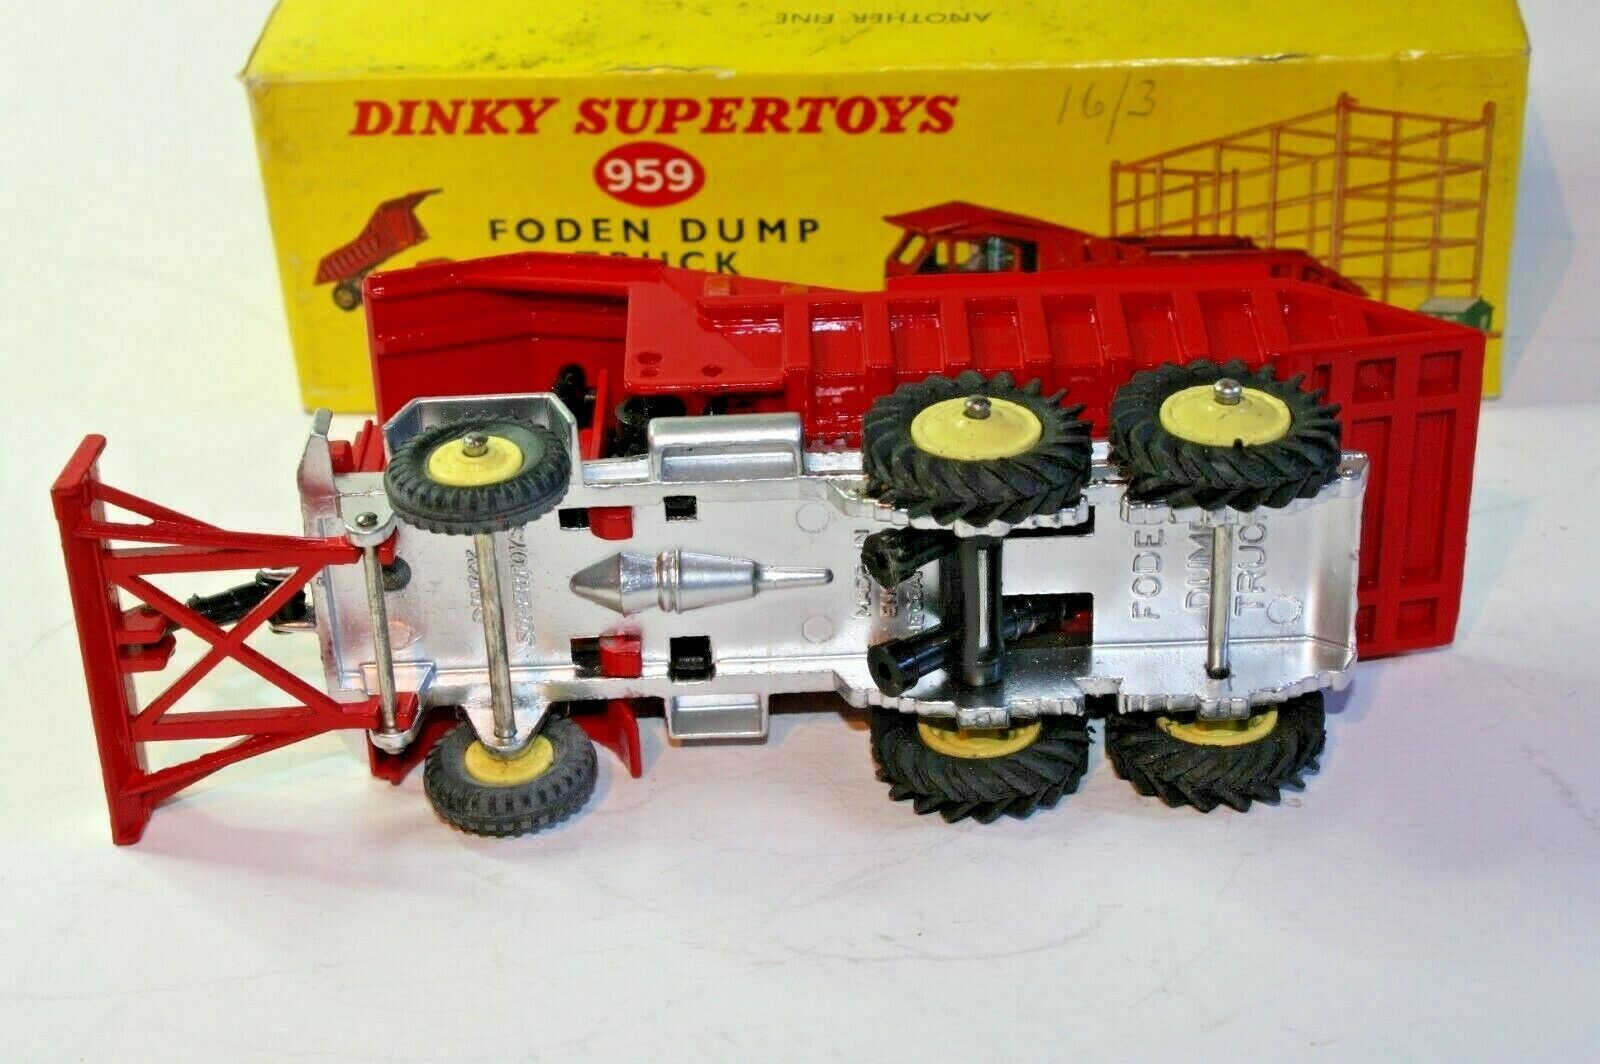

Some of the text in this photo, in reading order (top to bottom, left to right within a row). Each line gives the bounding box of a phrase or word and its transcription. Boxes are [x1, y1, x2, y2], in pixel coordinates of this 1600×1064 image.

[774, 12, 992, 24] ANOTHER FINE
[348, 95, 959, 135] DINKY SUPERTOYS
[603, 158, 695, 192] 959
[489, 218, 820, 242] FODEN DUMP
[1132, 529, 1164, 619] FODE
[1234, 521, 1267, 616] TRUC
